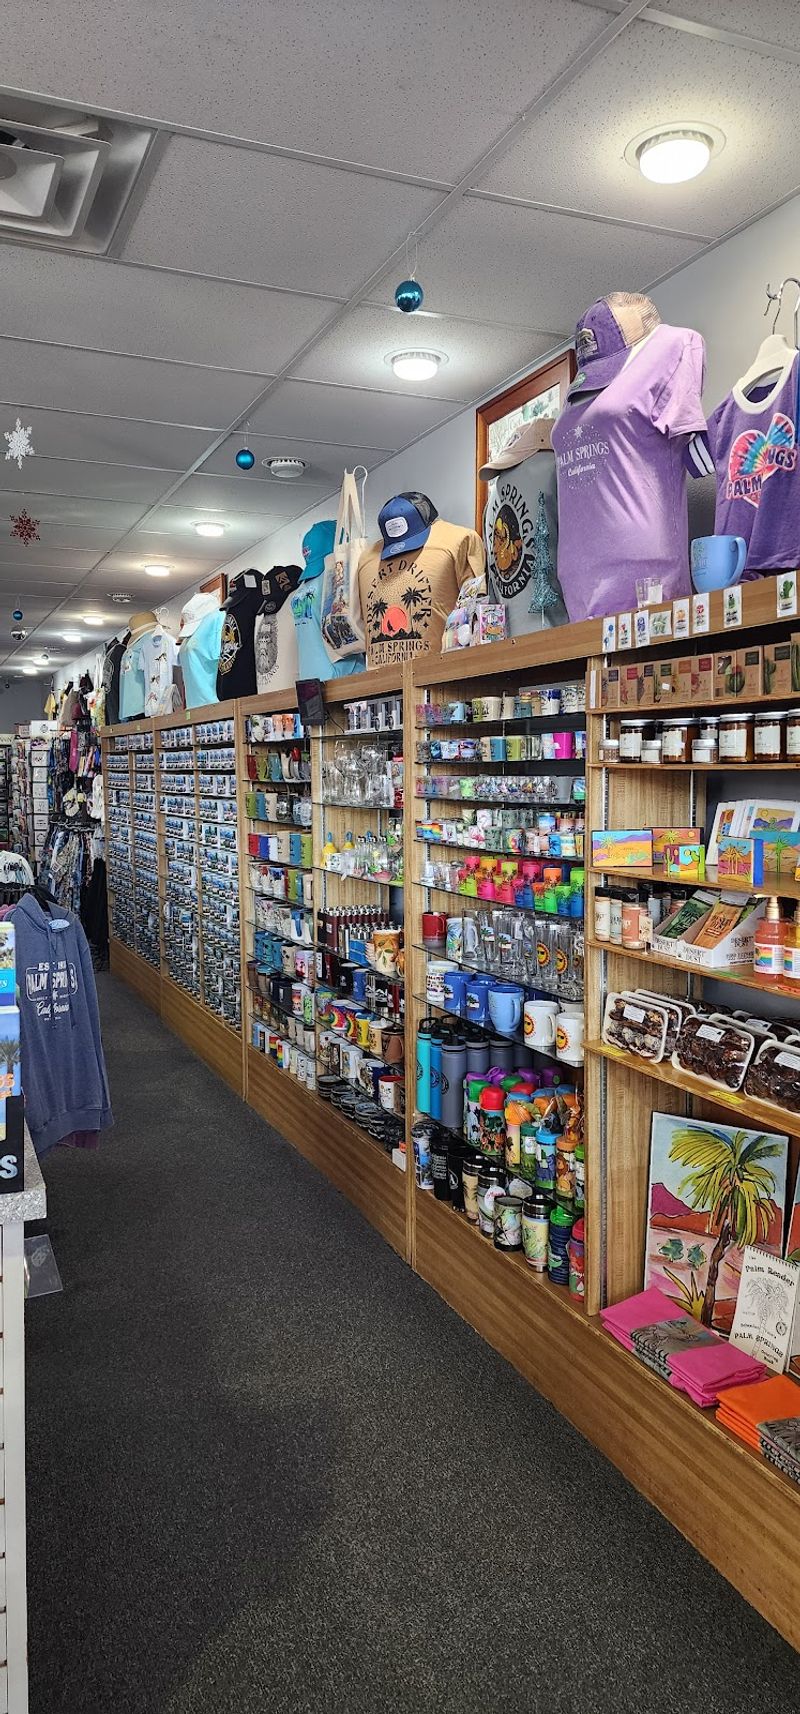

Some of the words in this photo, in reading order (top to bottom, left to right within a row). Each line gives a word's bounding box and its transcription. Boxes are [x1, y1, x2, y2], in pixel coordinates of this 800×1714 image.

[575, 441, 610, 460] SPRINGS
[567, 463, 596, 477] California
[398, 560, 432, 618] DRIFTER
[387, 640, 430, 652] SPRINGS
[745, 1264, 765, 1273] Palm
[767, 1266, 795, 1287] Reader
[734, 1332, 754, 1340] PALM
[756, 1334, 783, 1358] SPRINGS
